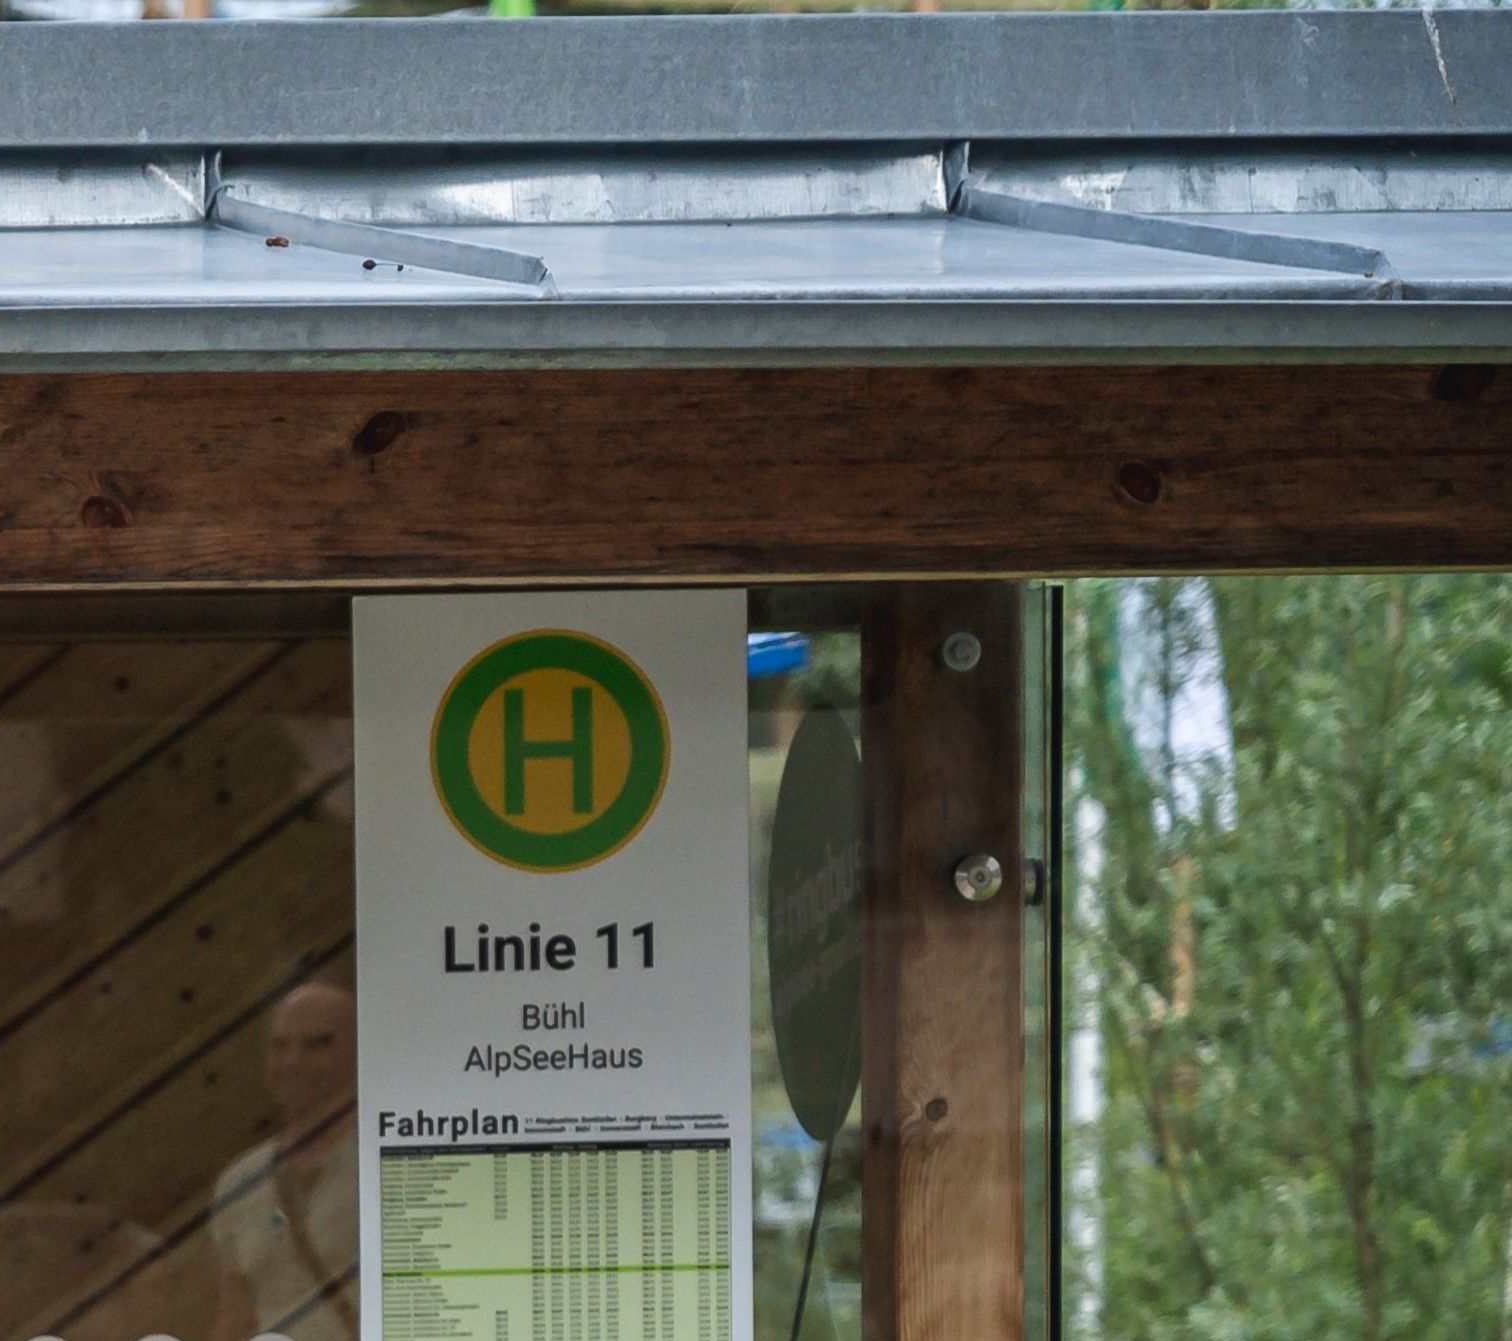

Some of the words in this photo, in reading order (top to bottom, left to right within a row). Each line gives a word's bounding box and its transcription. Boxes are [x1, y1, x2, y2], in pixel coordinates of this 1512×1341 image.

[444, 923, 576, 973] Linie
[596, 921, 656, 969] 11
[522, 1001, 586, 1030] Bühl
[464, 1043, 644, 1076] AlpSeeHaus
[378, 1108, 520, 1142] Fahrplan
